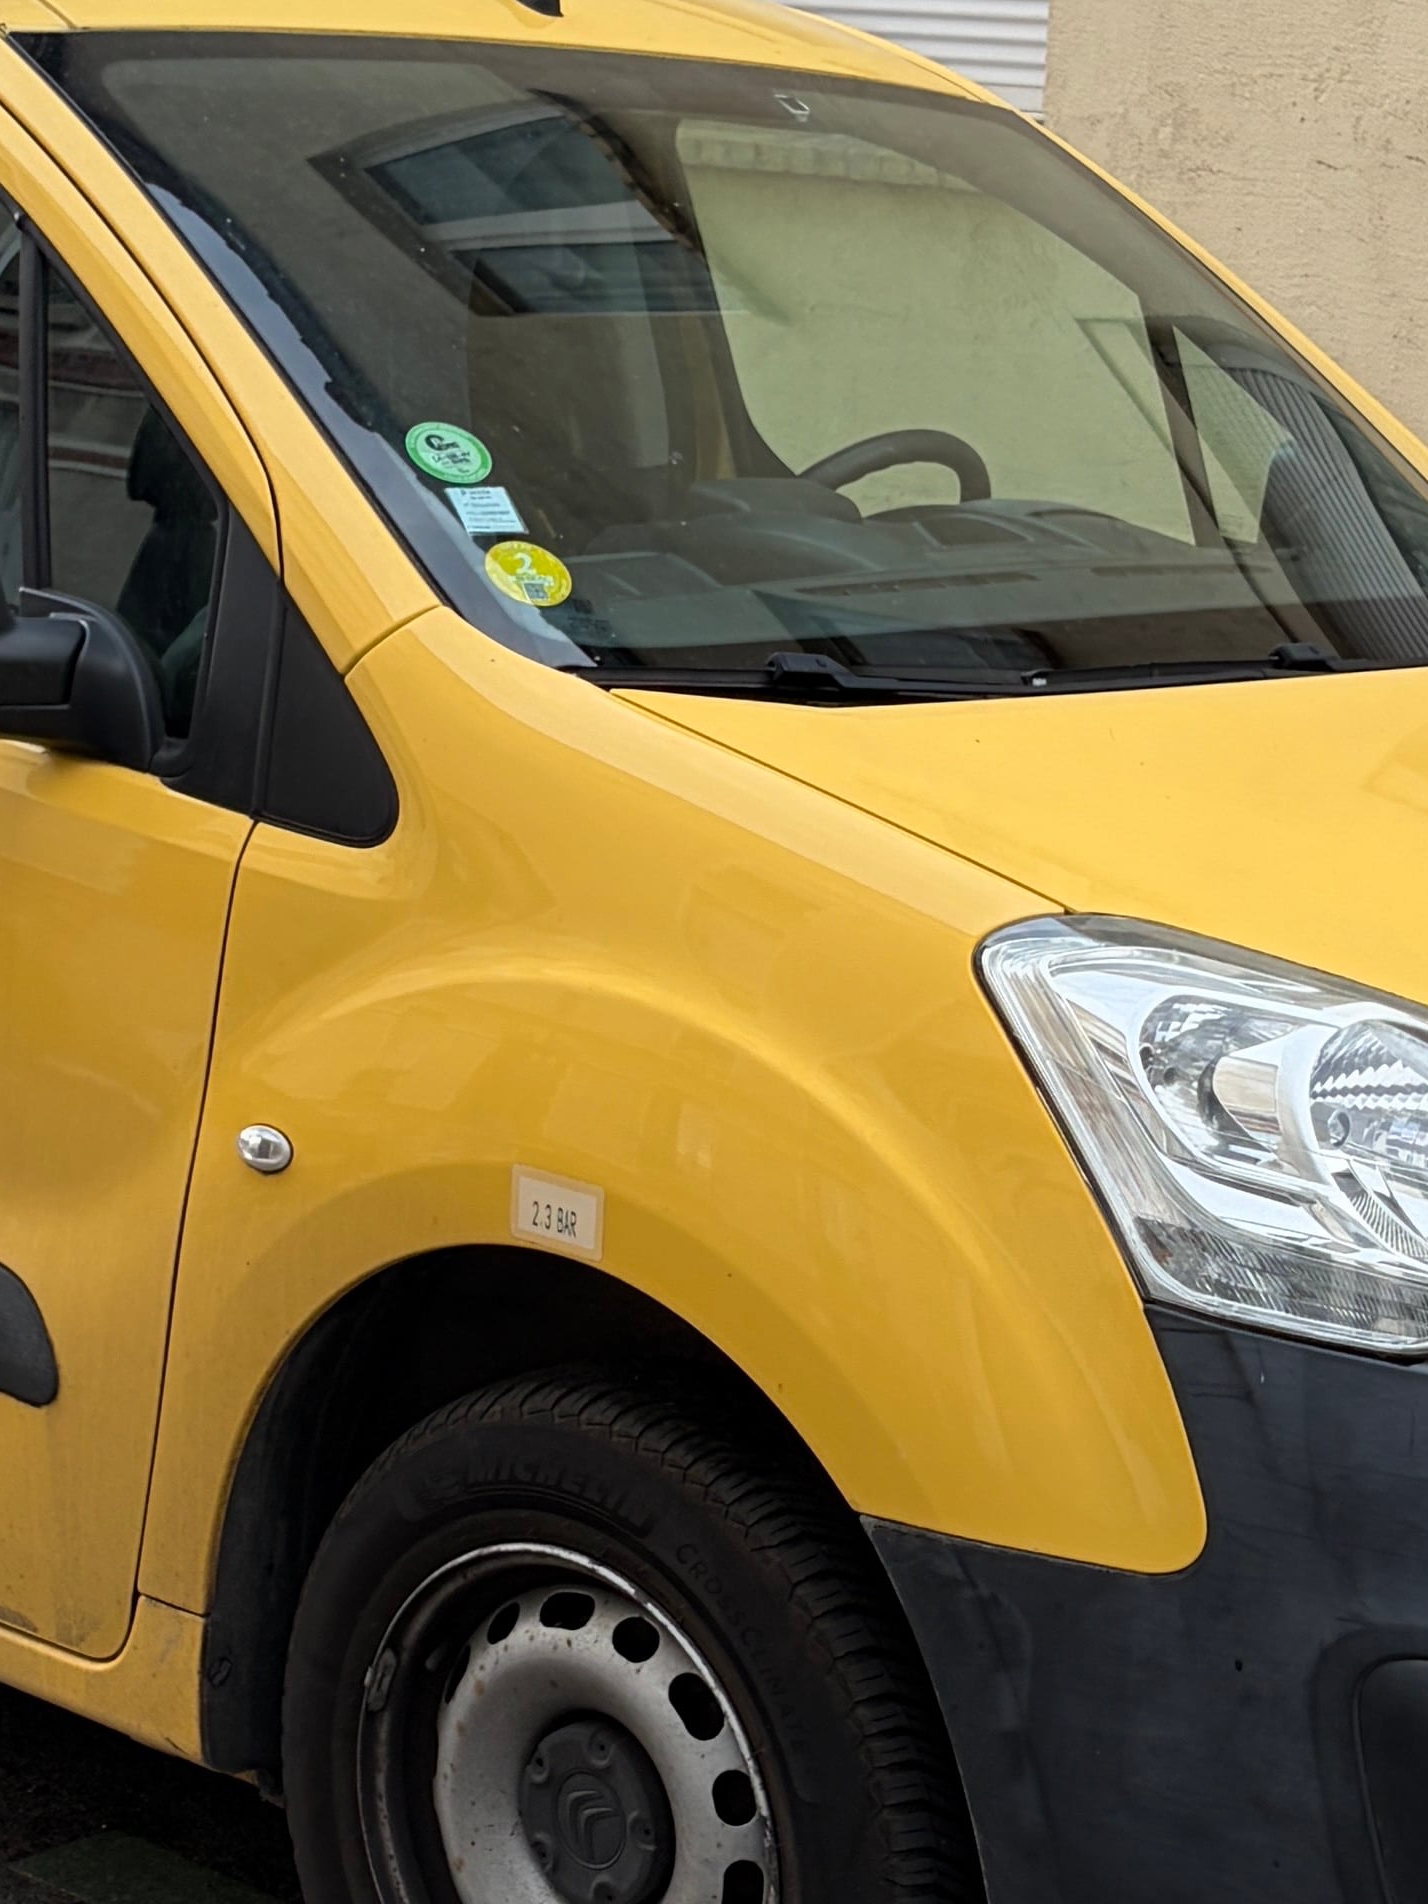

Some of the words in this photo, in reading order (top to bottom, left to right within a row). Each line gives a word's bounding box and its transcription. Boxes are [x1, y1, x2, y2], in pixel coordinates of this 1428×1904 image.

[557, 1207, 577, 1238] BAR
[466, 1455, 655, 1532] MICHELIN
[675, 1542, 807, 1752] CROSSCLIMATE
